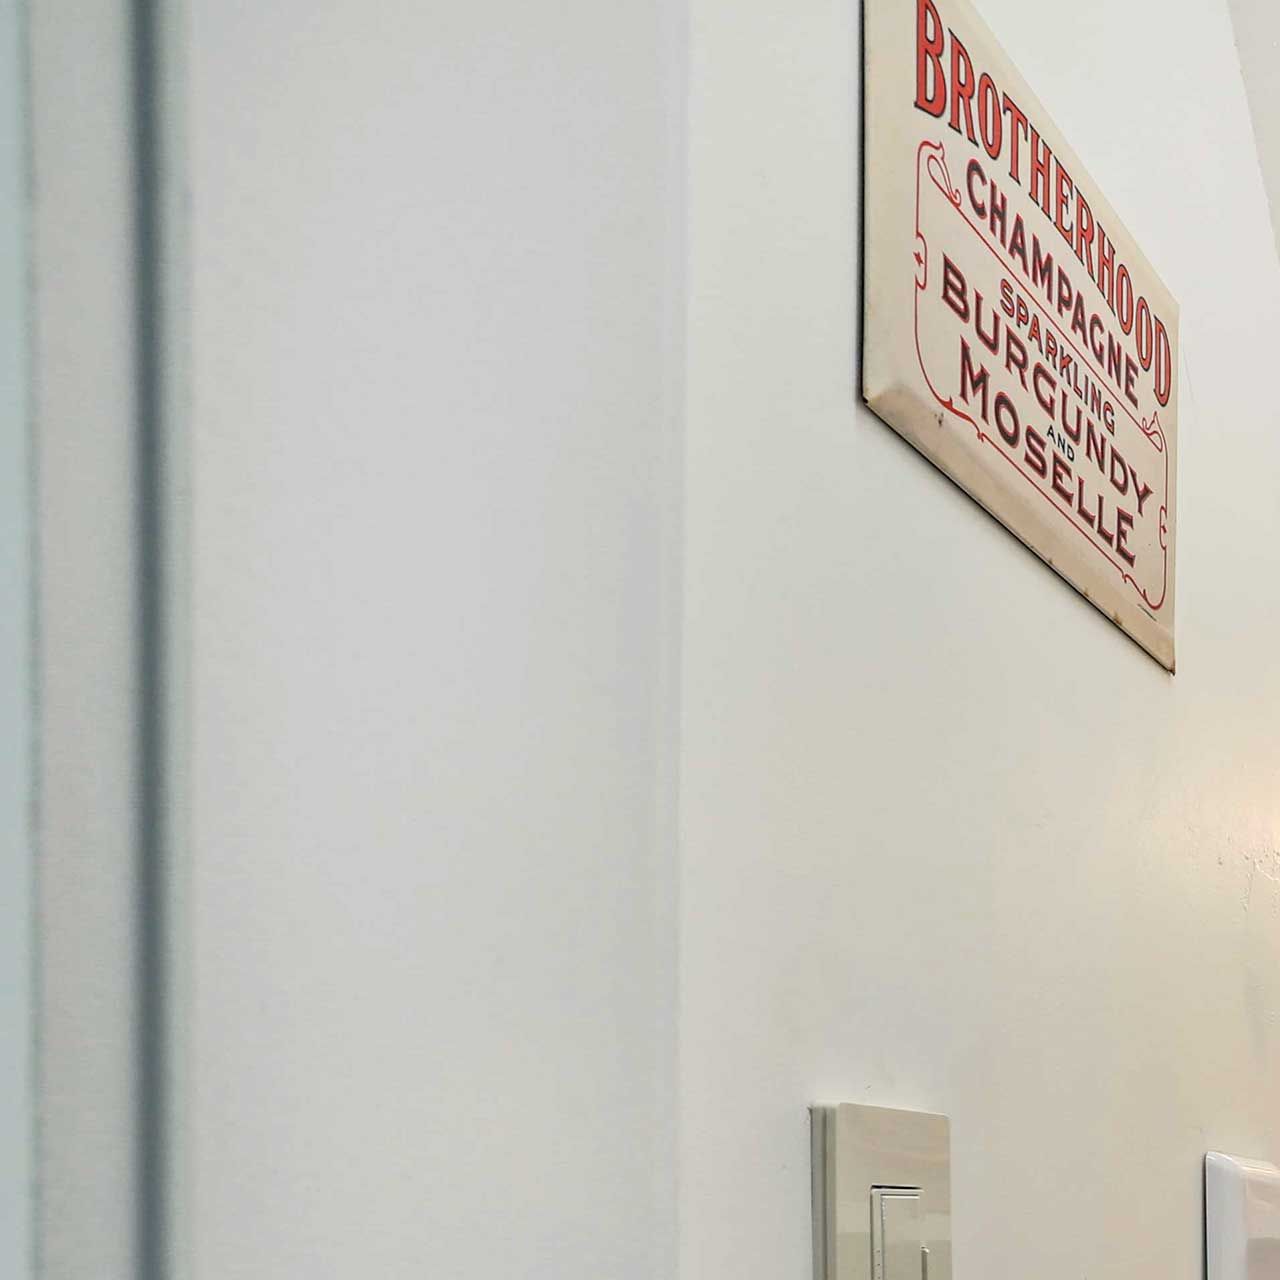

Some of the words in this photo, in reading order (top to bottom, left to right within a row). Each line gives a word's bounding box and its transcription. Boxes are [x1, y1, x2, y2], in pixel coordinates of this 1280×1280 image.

[913, 0, 1171, 407] BROTHERHOOD
[965, 158, 1139, 410] CHAMPAGNE
[941, 249, 1153, 519] BURGUNDY
[957, 333, 1136, 569] MOSELLE
[999, 277, 1116, 437] SPARKLING
[1046, 423, 1076, 464] AND
